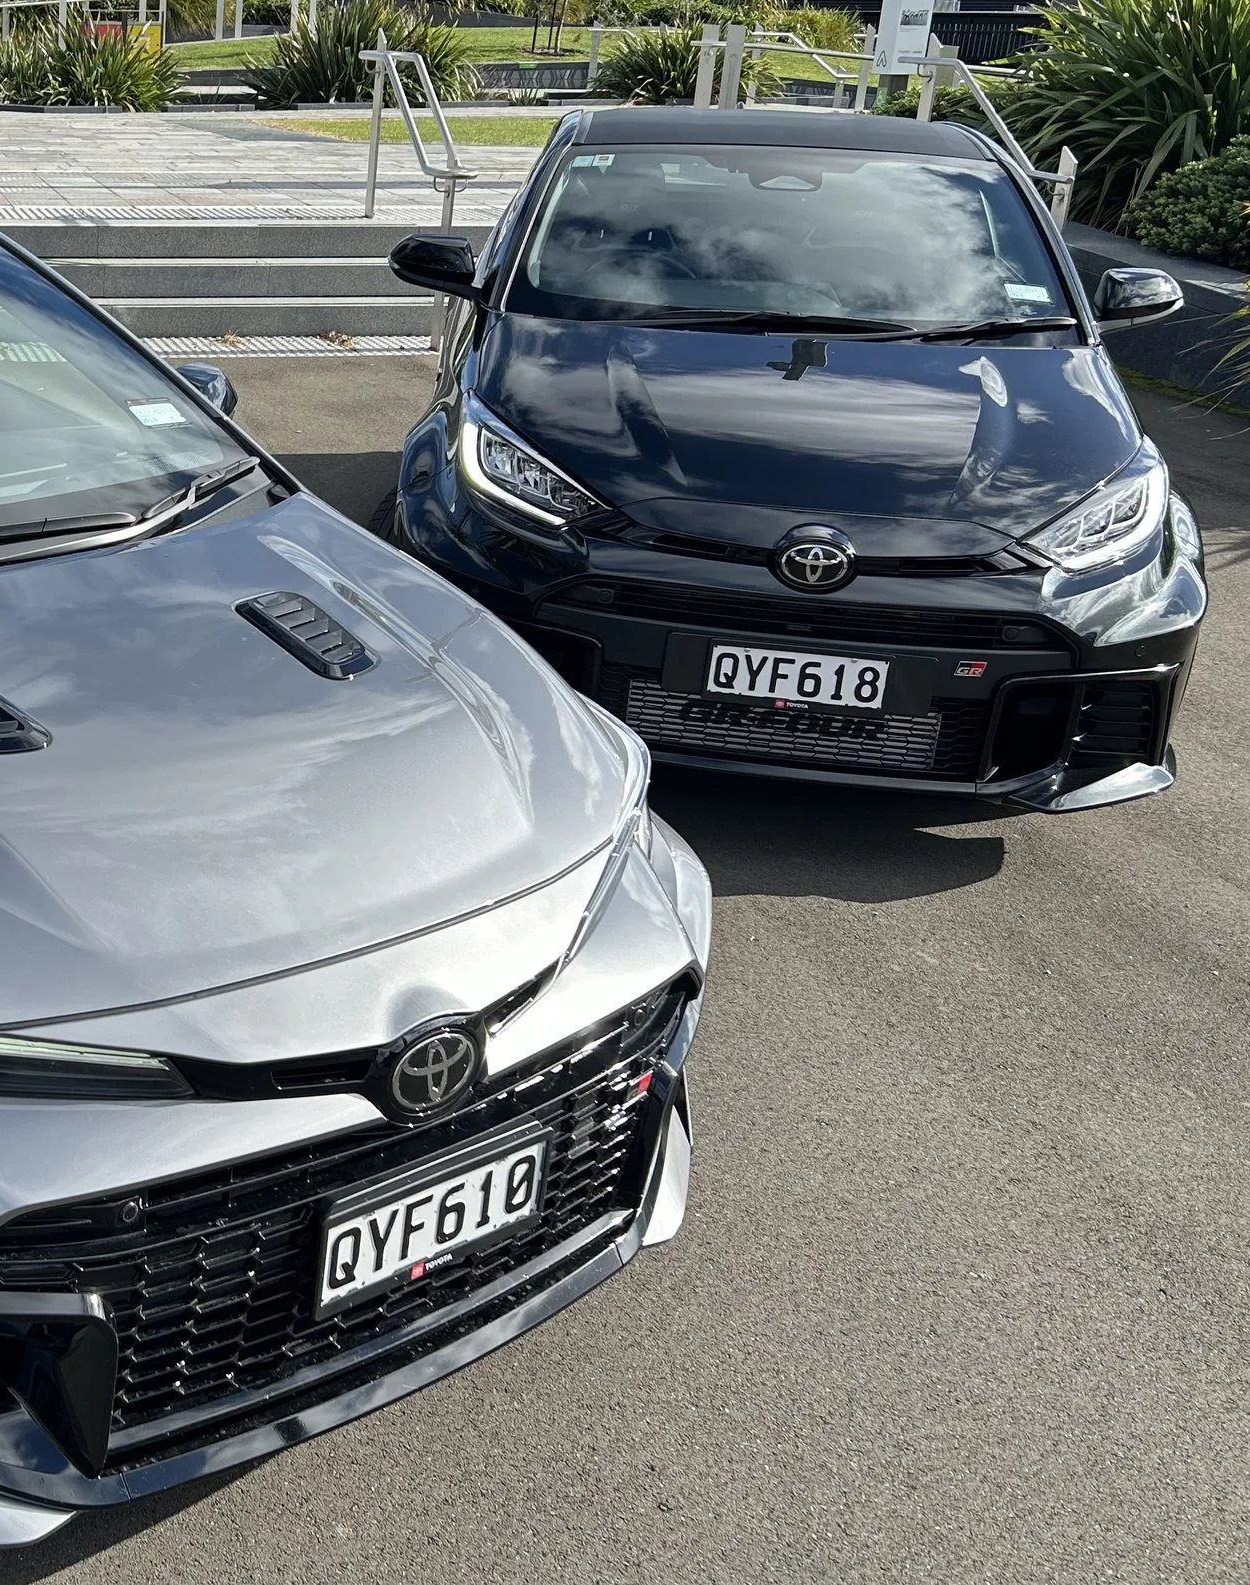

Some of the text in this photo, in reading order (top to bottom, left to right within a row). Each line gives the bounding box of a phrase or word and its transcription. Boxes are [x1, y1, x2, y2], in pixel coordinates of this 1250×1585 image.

[713, 652, 881, 704] QYF618
[955, 665, 984, 676] GR
[785, 701, 809, 709] TOYOTA
[327, 1154, 536, 1290] QYF610
[425, 1253, 453, 1271] TOYOTA
